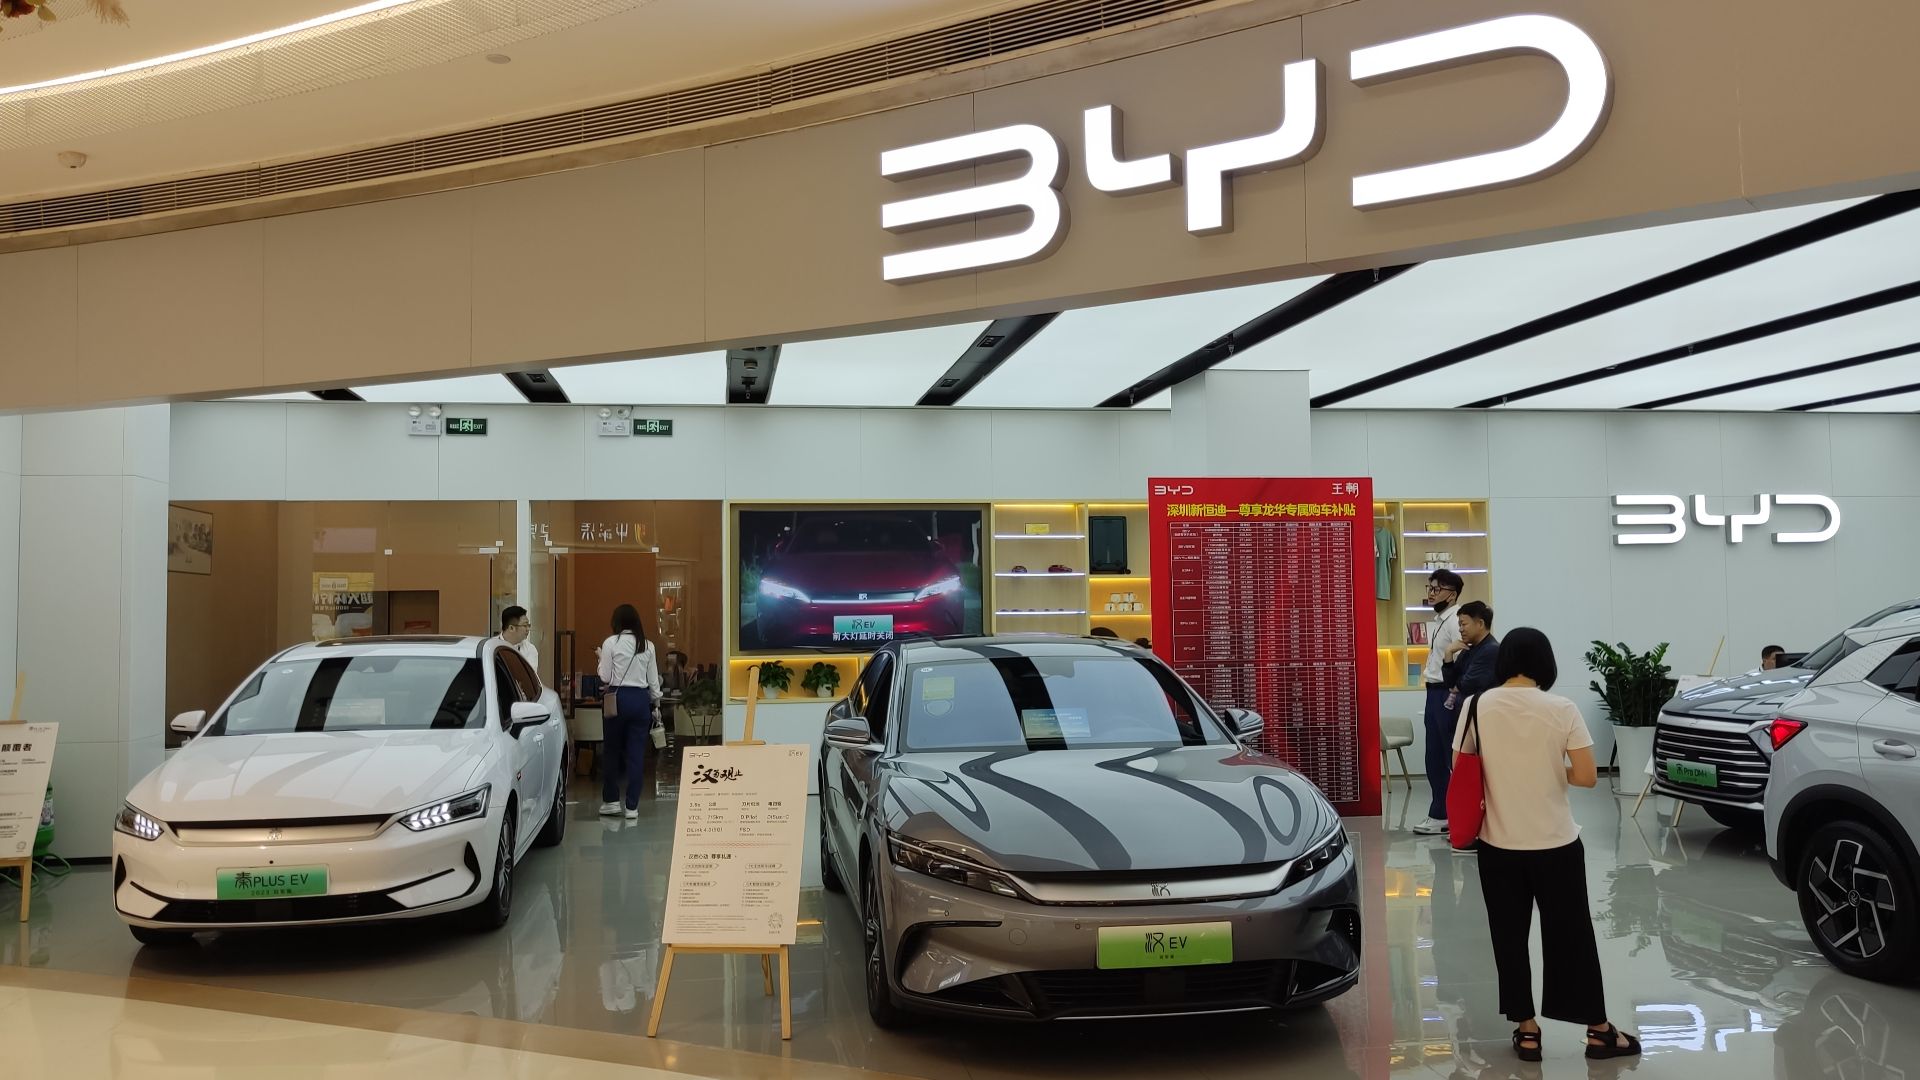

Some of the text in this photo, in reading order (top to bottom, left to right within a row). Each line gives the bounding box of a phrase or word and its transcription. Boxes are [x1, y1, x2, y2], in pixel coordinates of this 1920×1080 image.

[881, 13, 1612, 283] BYD
[1154, 485, 1194, 495] BYD
[1611, 493, 1841, 546] BYD
[833, 632, 893, 641] 前大灯延时关闭
[290, 873, 309, 886] EV
